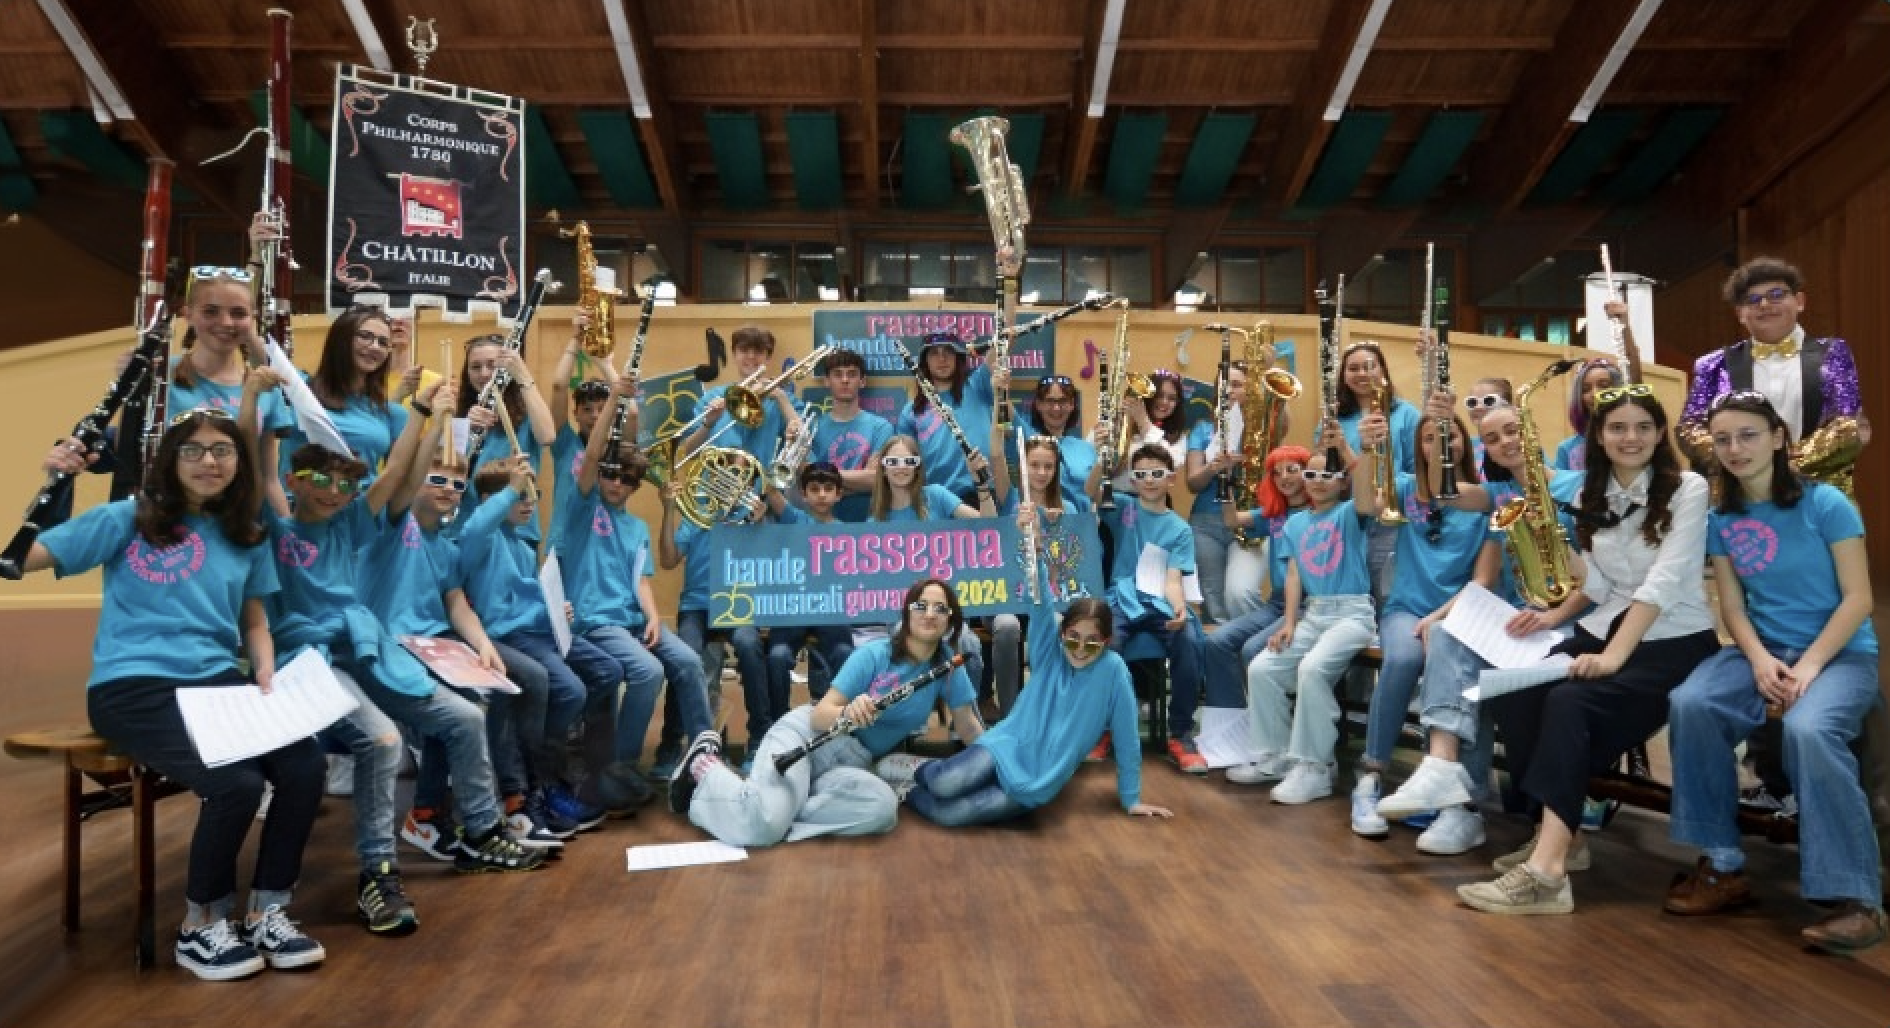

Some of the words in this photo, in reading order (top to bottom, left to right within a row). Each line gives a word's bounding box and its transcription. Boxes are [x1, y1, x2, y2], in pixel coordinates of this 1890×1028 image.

[361, 121, 499, 156] PHILHARMONIQUE
[407, 113, 459, 133] CORPS
[408, 272, 451, 286] ITALIE
[865, 313, 994, 342] rassegn
[724, 548, 806, 586] bande
[808, 529, 1004, 580] rassegna
[709, 581, 756, 626] 25
[754, 583, 844, 616] musicali
[845, 582, 909, 618] giova
[955, 578, 1007, 607] 2024
